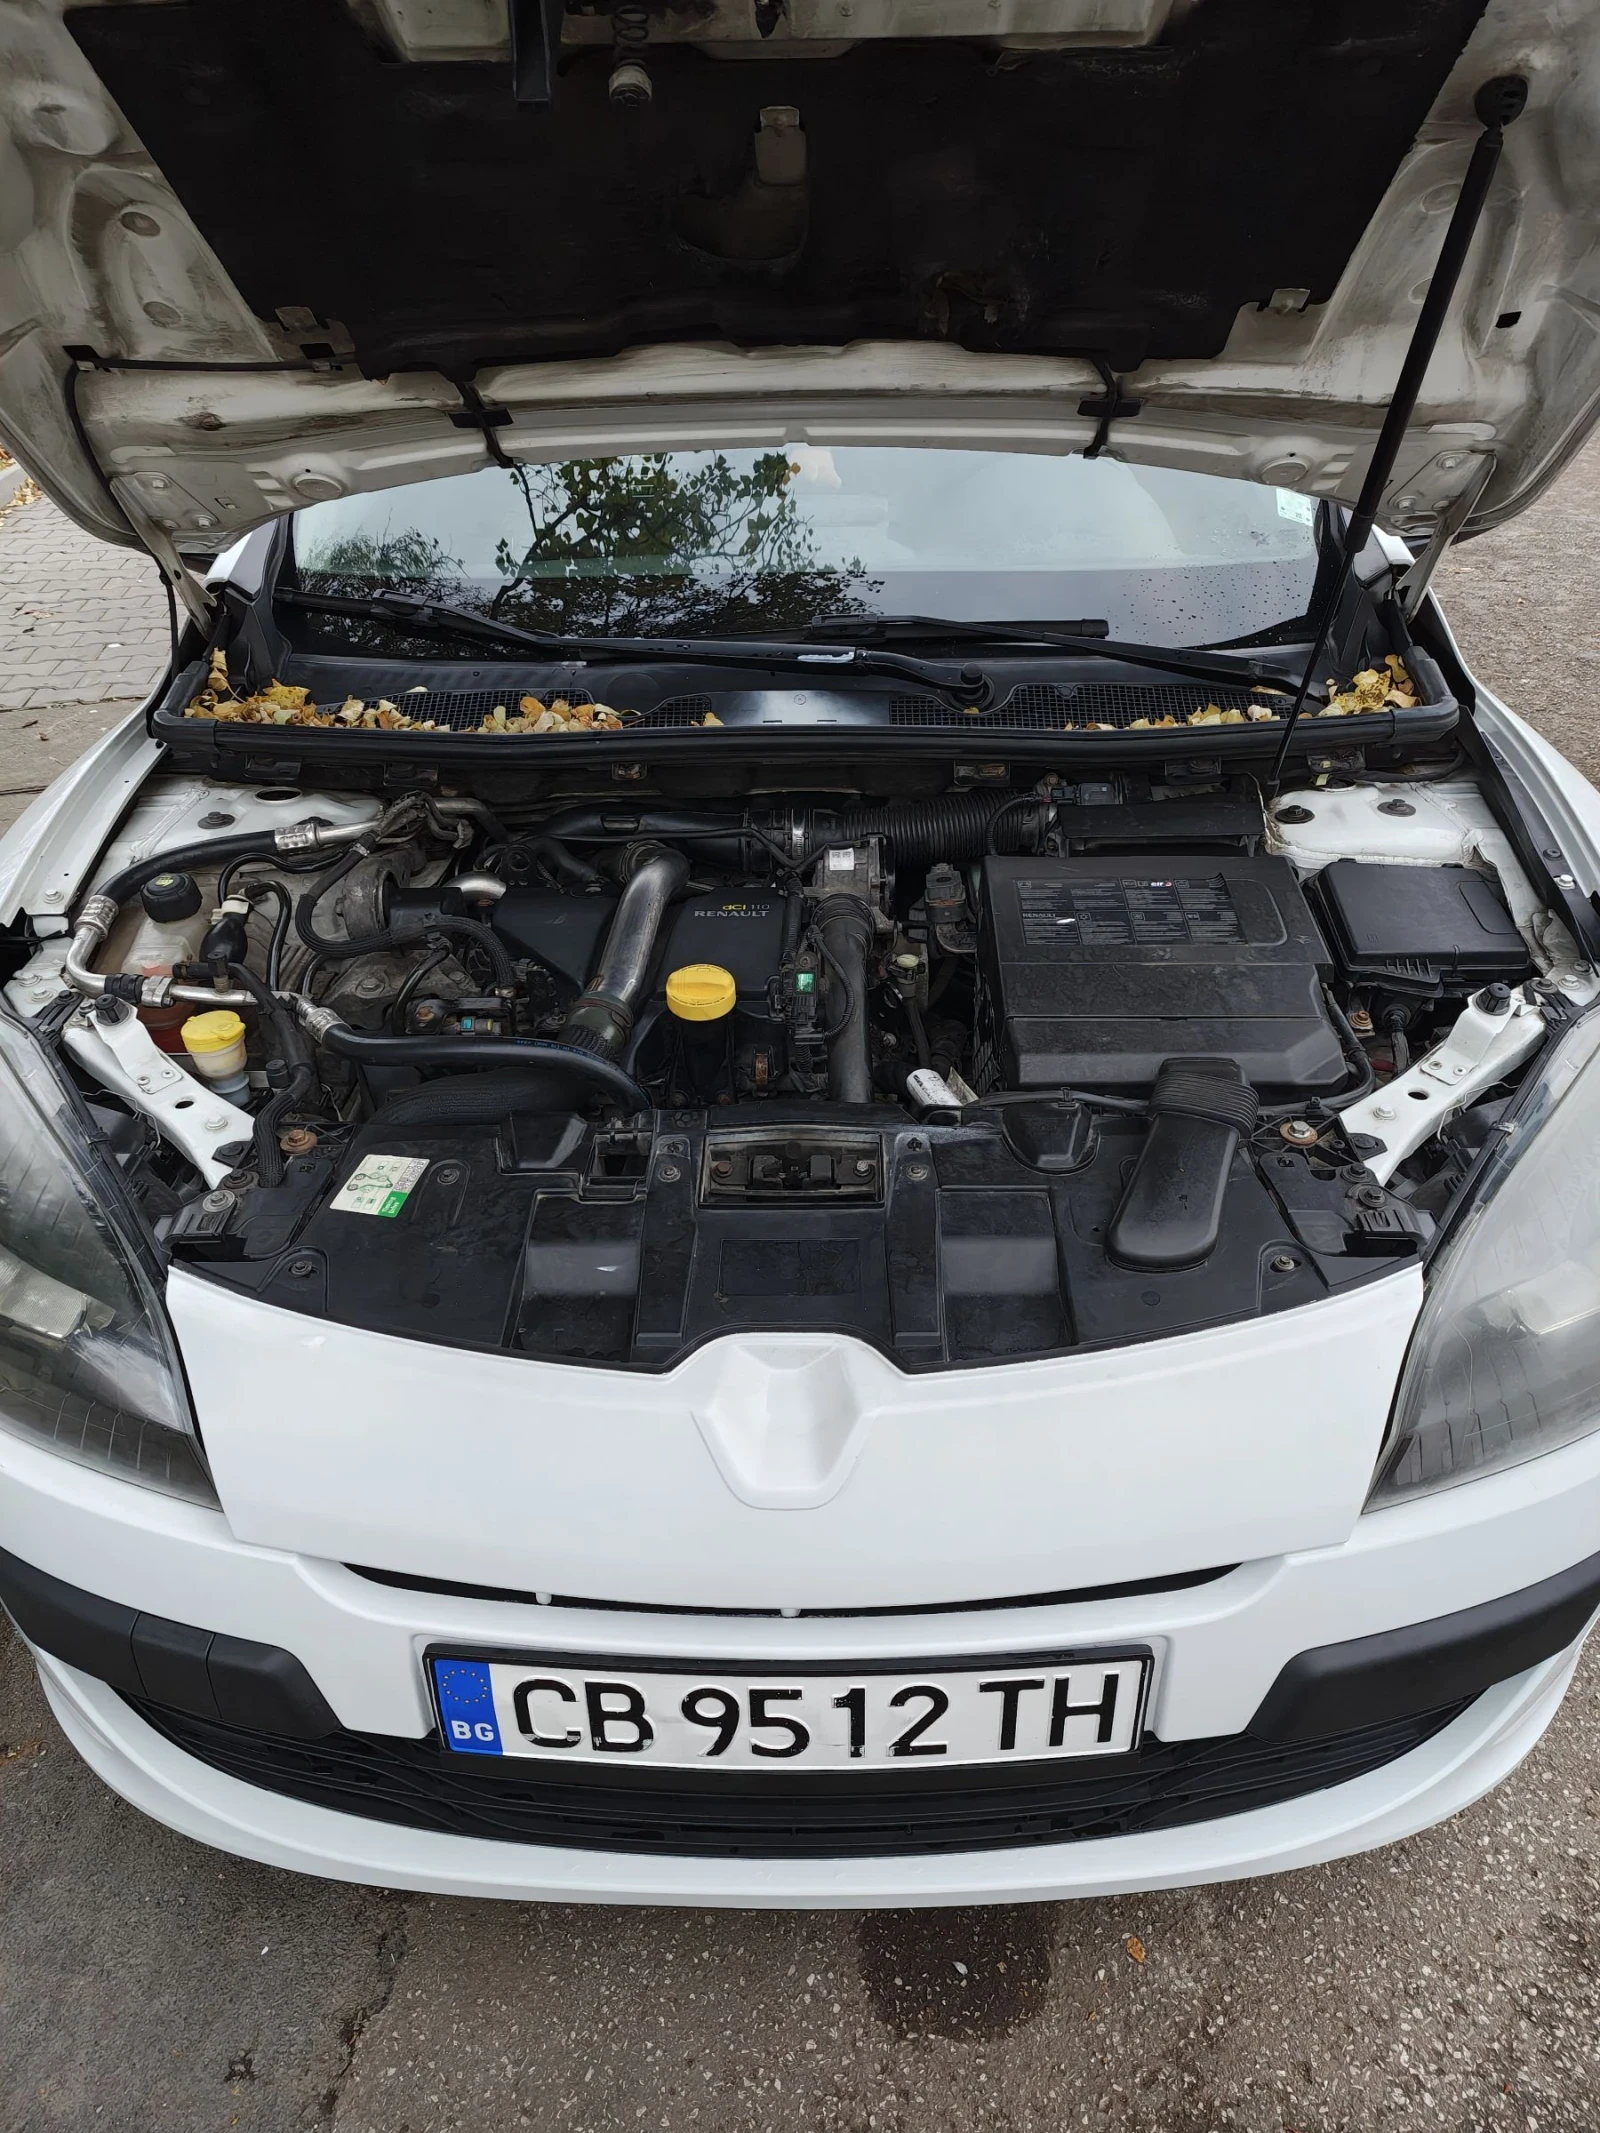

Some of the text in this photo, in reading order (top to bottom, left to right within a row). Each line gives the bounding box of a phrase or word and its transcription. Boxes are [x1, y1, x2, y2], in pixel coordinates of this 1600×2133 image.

[452, 1721, 495, 1743] BG
[513, 1673, 1119, 1757] CB 9512 TH
